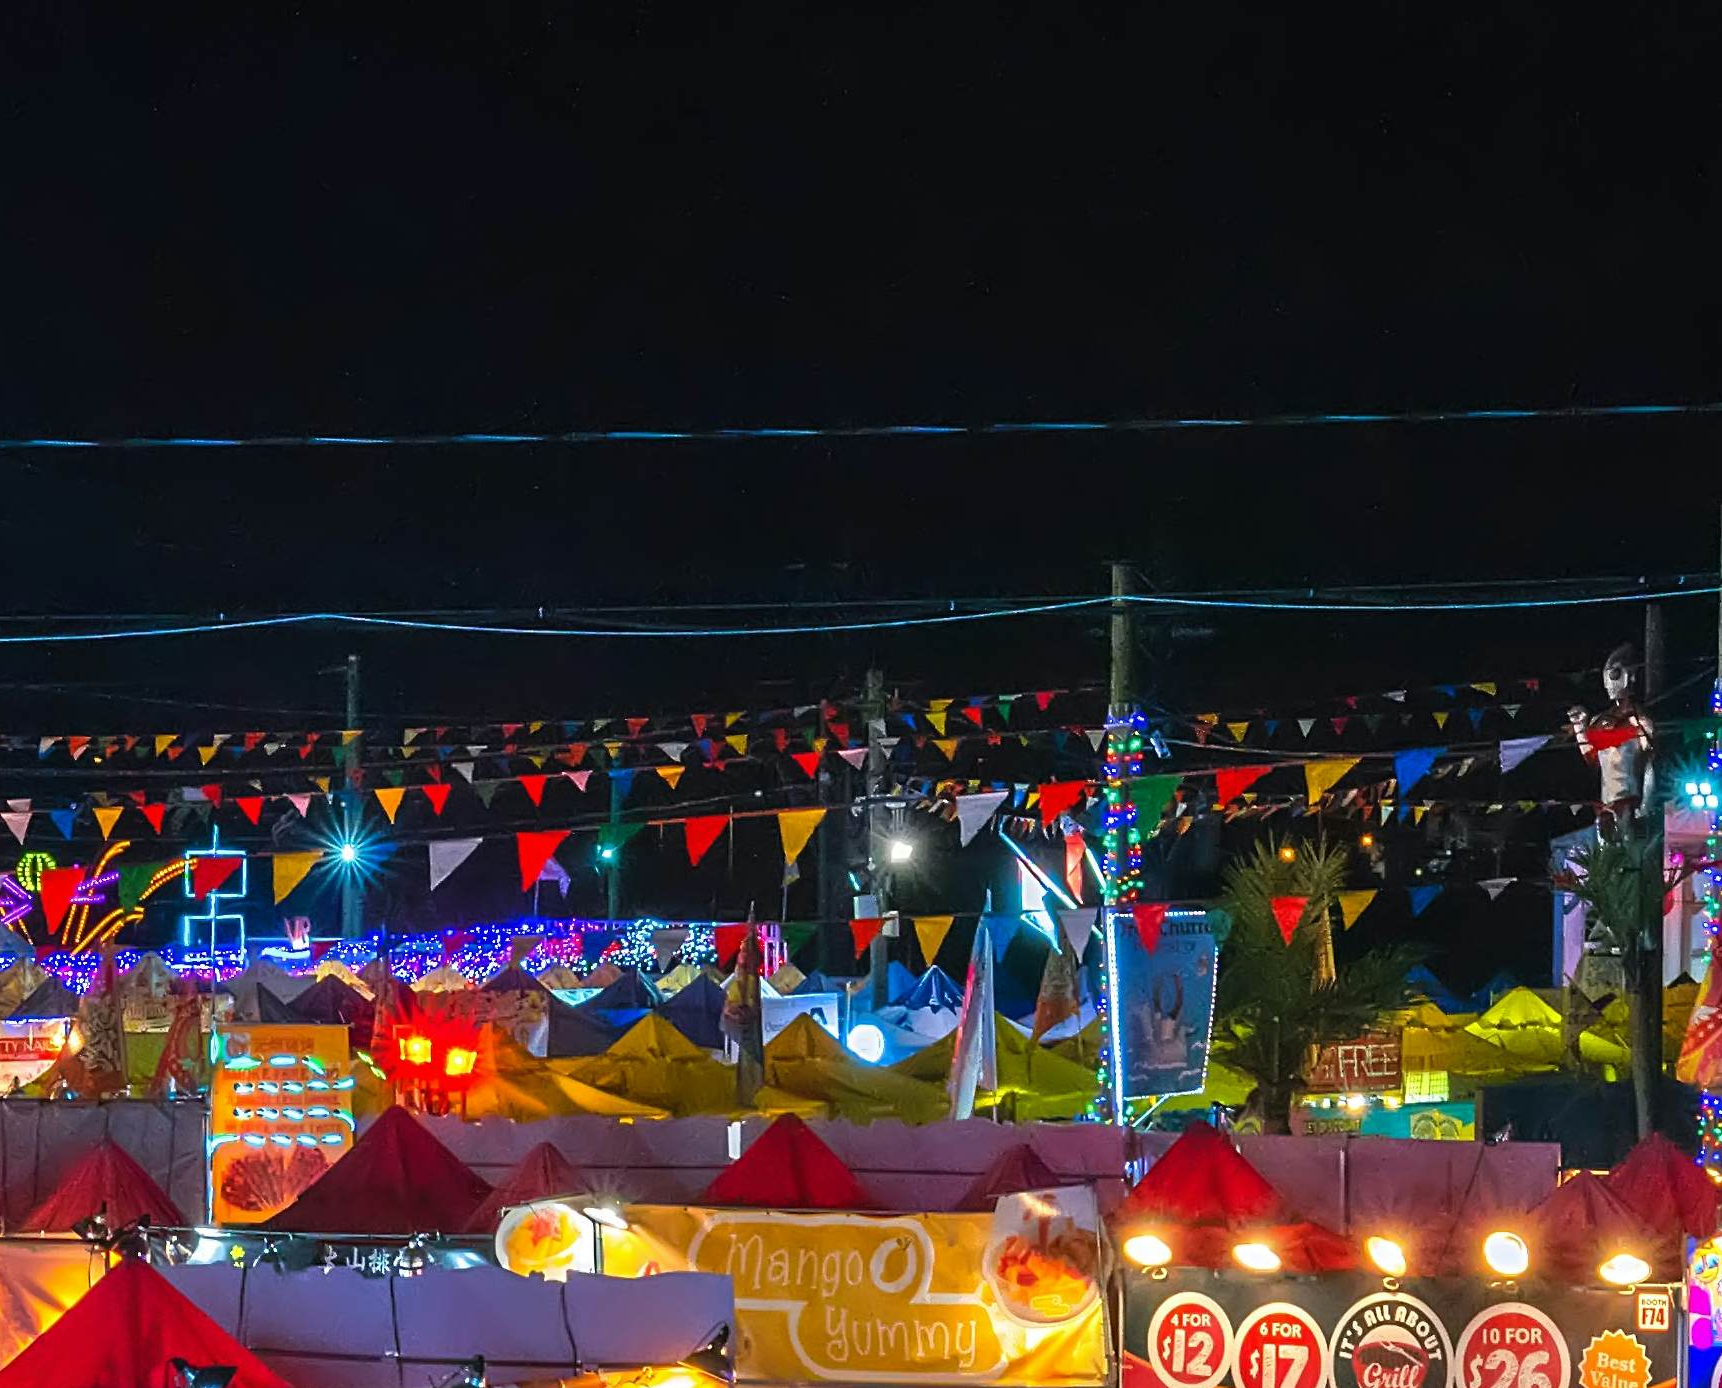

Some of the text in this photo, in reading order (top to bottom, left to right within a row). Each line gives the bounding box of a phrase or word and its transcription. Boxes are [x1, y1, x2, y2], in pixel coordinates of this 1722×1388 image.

[727, 1233, 864, 1297] Mango
[1641, 1298, 1667, 1307] BOOTH
[1170, 1313, 1213, 1328] 4 FOR
[1642, 1307, 1665, 1326] F74
[825, 1304, 977, 1369] Yummy
[1259, 1323, 1302, 1338] 6 FOR
[1338, 1304, 1443, 1362] IT'S ALL ABOUT
[1482, 1327, 1544, 1345] 10 FOR
[1162, 1328, 1214, 1377] $12
[1596, 1351, 1637, 1374] Best
